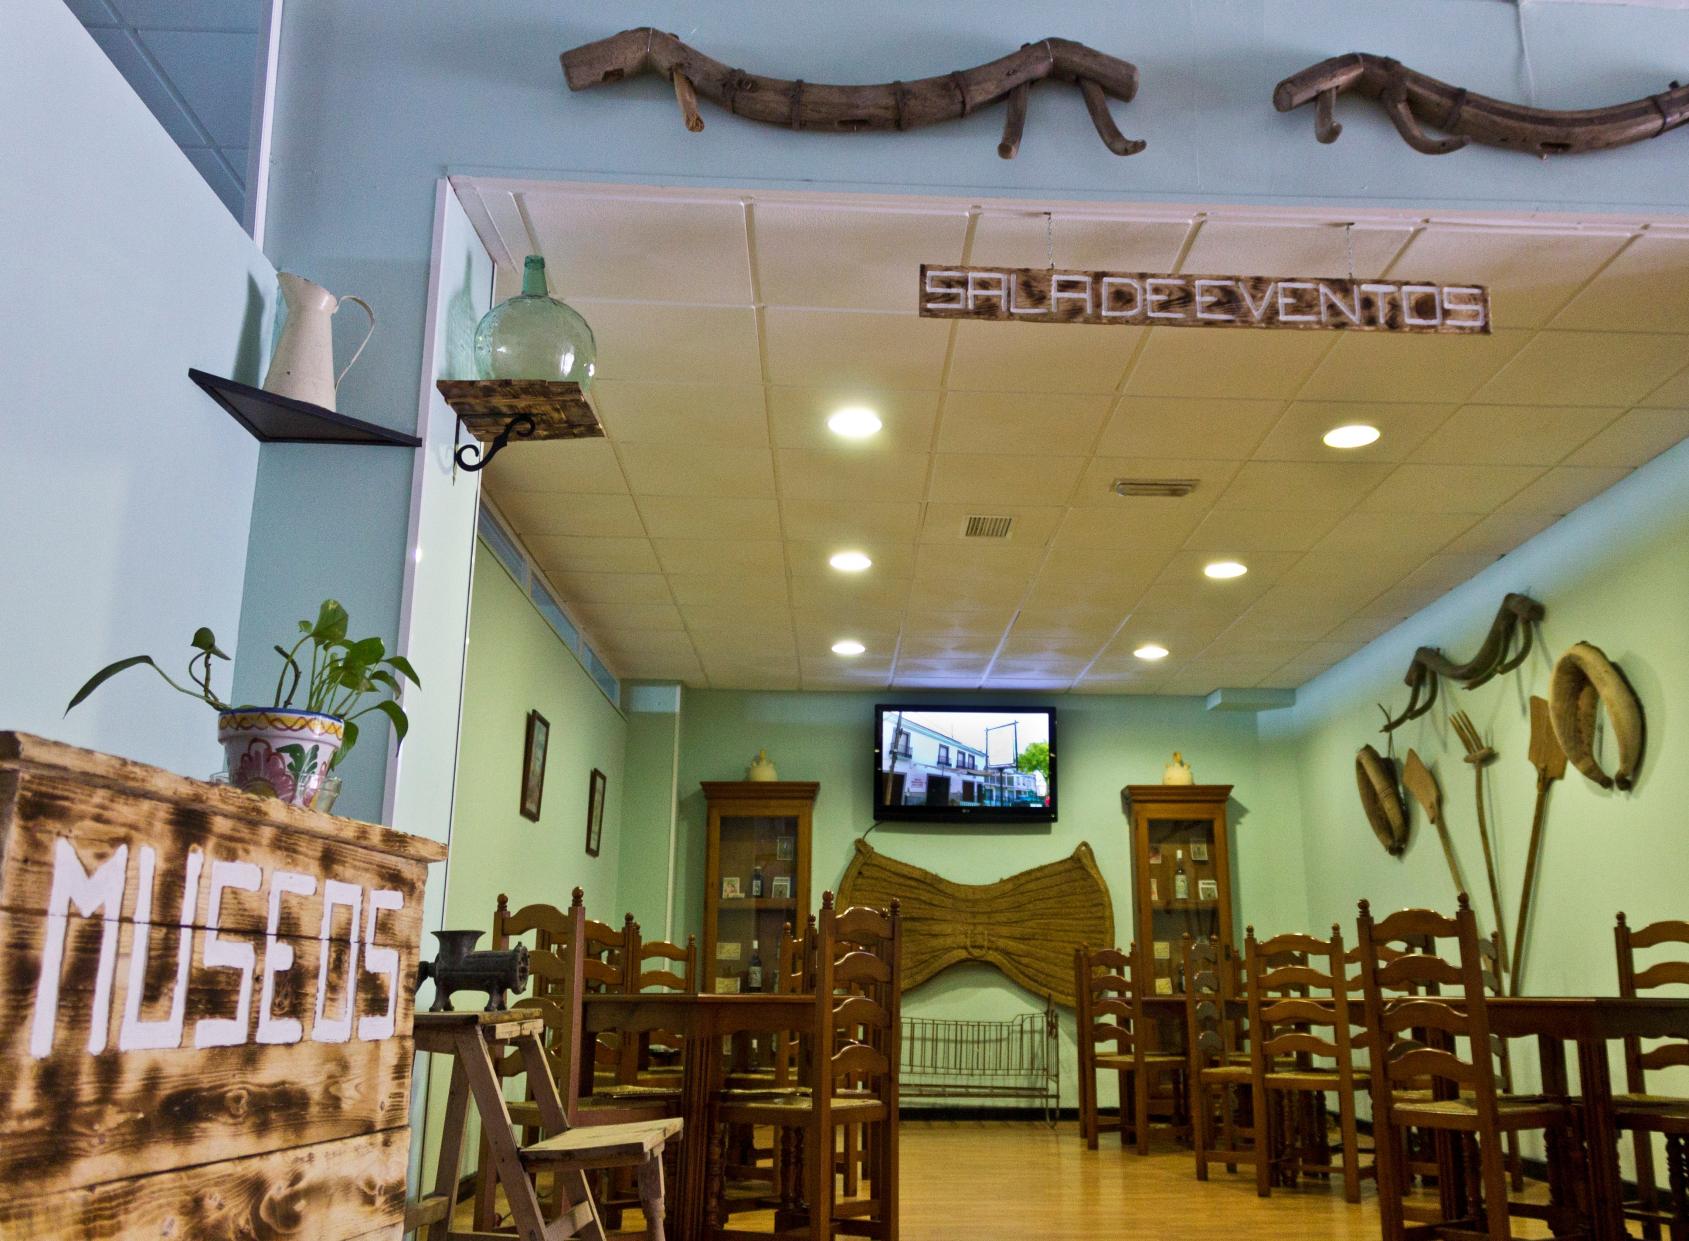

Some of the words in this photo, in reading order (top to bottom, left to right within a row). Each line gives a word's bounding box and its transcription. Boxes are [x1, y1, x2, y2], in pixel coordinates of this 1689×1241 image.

[926, 271, 1092, 314] SALA
[1102, 277, 1186, 318] DE
[1195, 280, 1485, 327] EVENTOS
[30, 836, 404, 1059] MUSEOS
